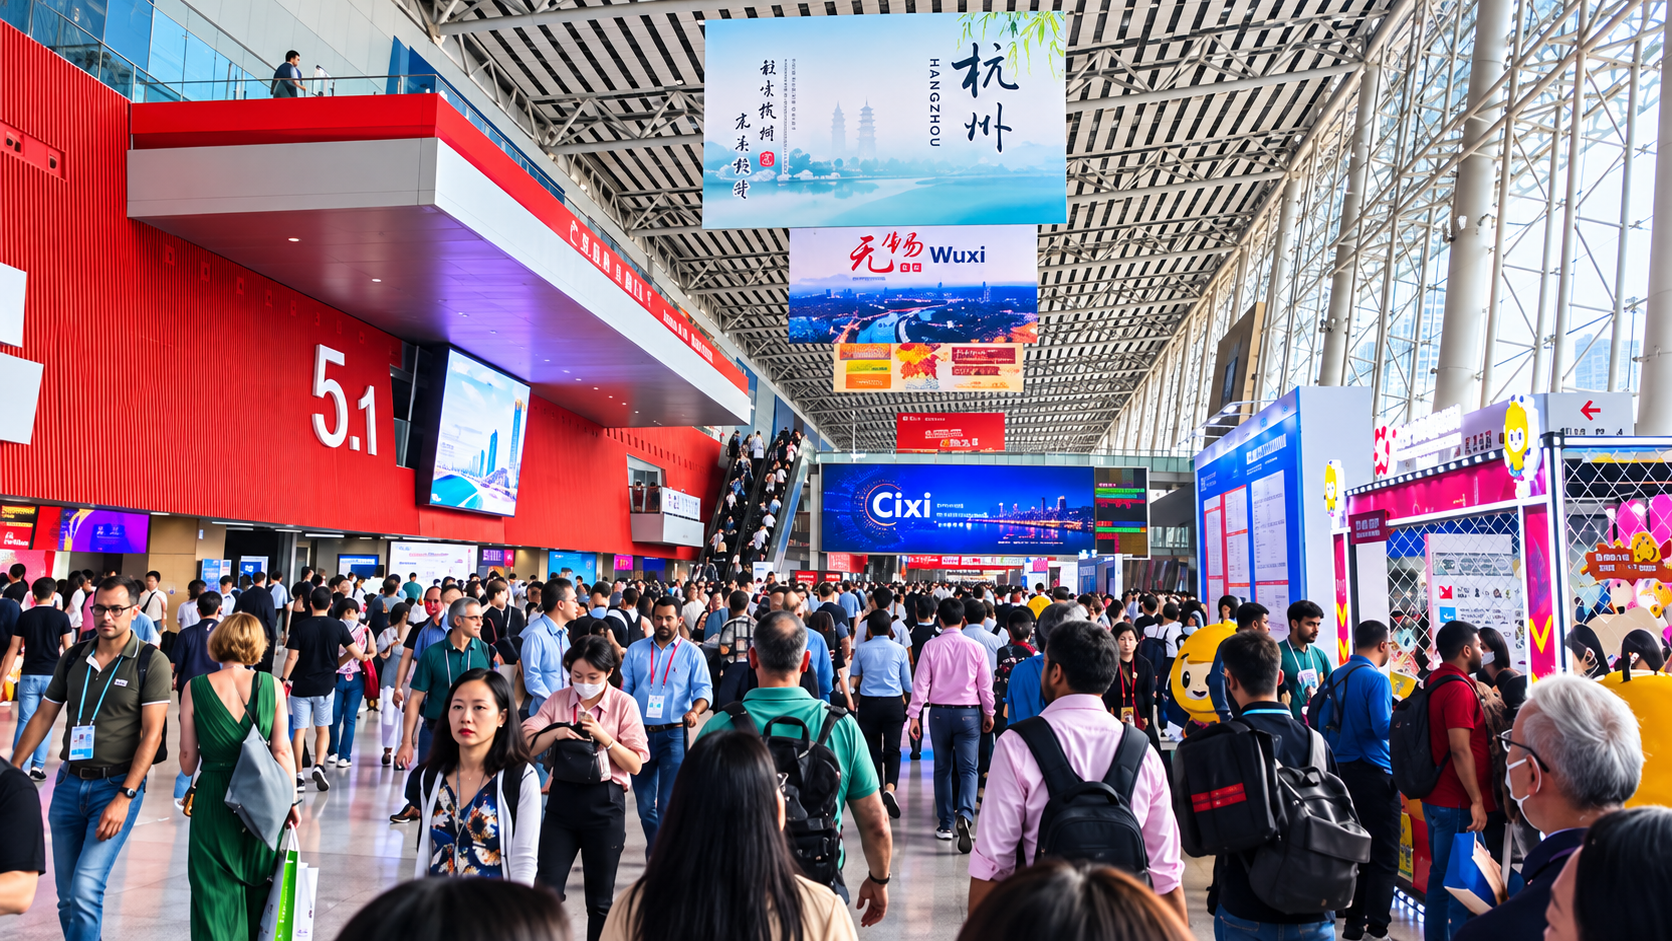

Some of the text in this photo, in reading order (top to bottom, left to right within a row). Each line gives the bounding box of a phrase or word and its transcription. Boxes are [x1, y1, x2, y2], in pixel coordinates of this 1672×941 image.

[929, 58, 941, 147] HANGZHOU
[951, 42, 1019, 153] 杭州
[929, 246, 986, 264] Wuxi
[312, 344, 377, 456] 5.1
[872, 491, 931, 518] Cixi
